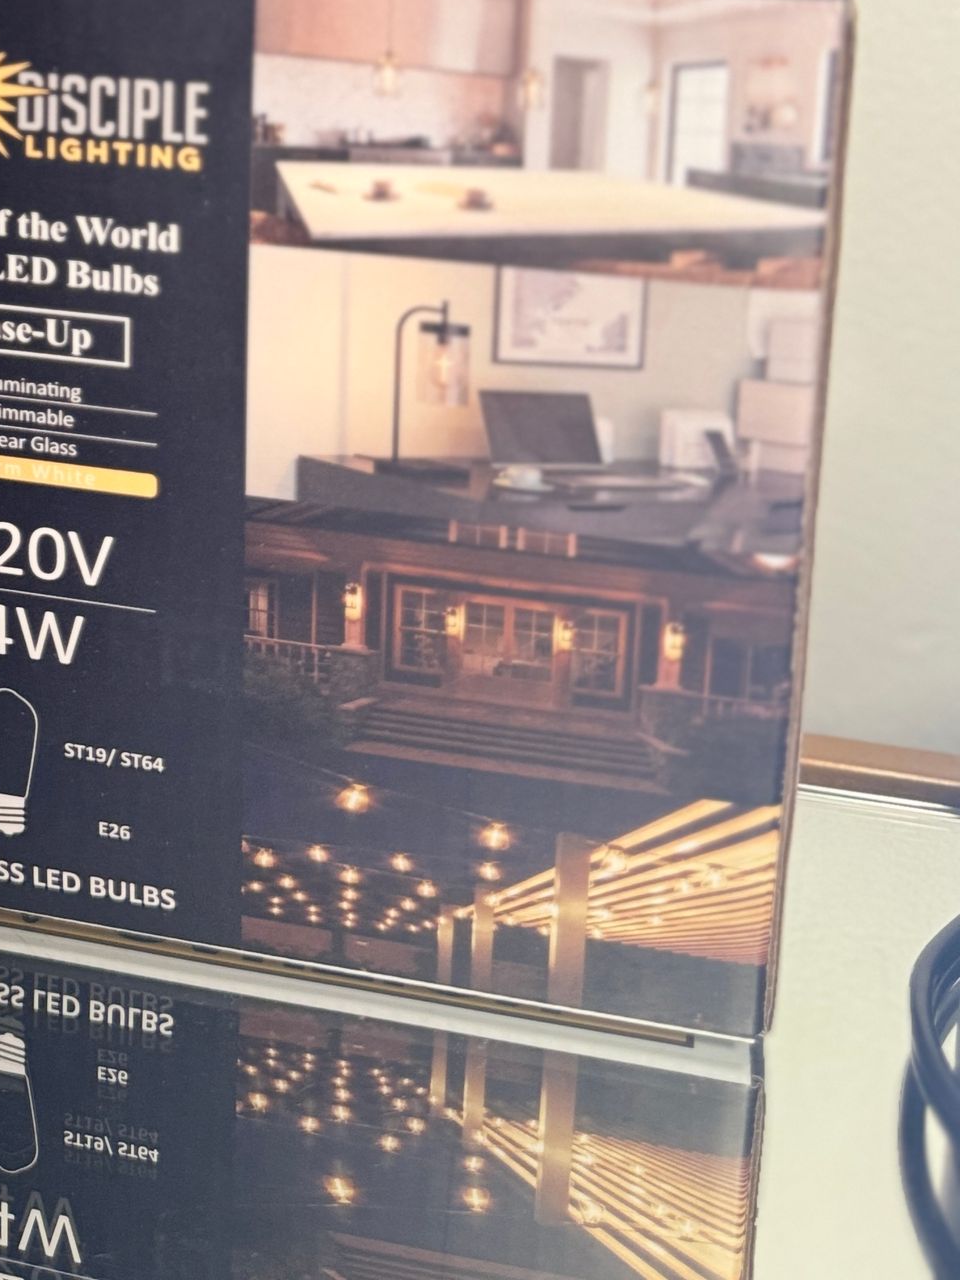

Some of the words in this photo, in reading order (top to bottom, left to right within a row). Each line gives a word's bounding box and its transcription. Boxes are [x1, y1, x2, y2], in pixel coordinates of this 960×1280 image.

[25, 134, 202, 172] LIGHTING
[17, 211, 68, 243] the
[75, 215, 181, 254] World
[66, 259, 160, 297] Bulbs
[30, 434, 78, 457] Glass
[32, 462, 97, 488] White
[64, 742, 117, 768] ST19/
[120, 751, 165, 774] ST64
[98, 820, 132, 841] E26
[32, 864, 81, 895] LED
[89, 874, 177, 910] BULBS
